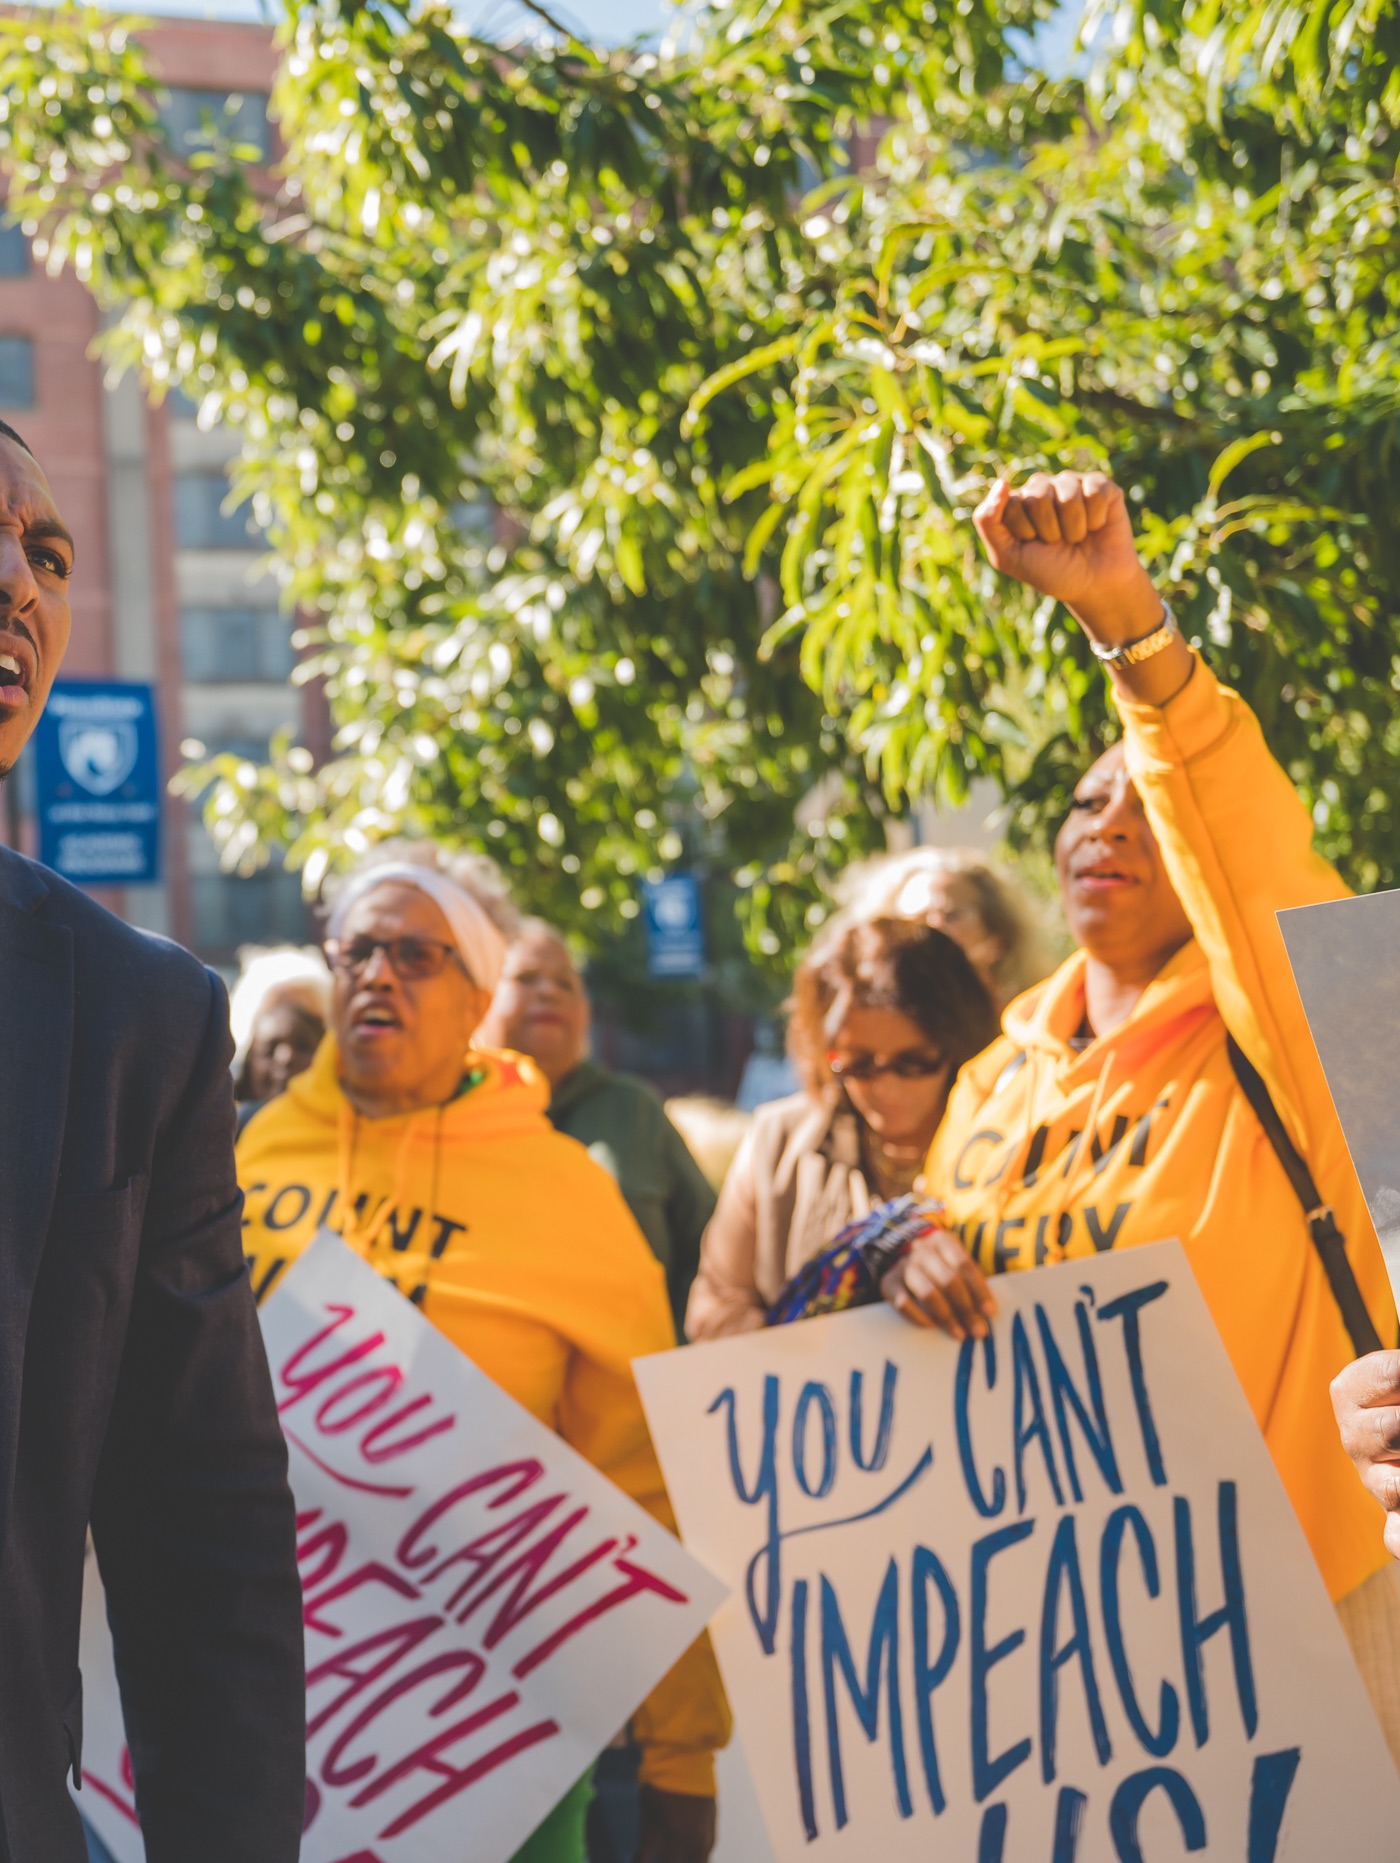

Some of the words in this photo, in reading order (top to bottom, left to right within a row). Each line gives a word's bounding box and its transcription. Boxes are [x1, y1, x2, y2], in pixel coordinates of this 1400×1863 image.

[954, 1280, 1170, 1520] CAN'T
[396, 1457, 690, 1680] CAN'T
[789, 1480, 1259, 1844] IMPEACH
